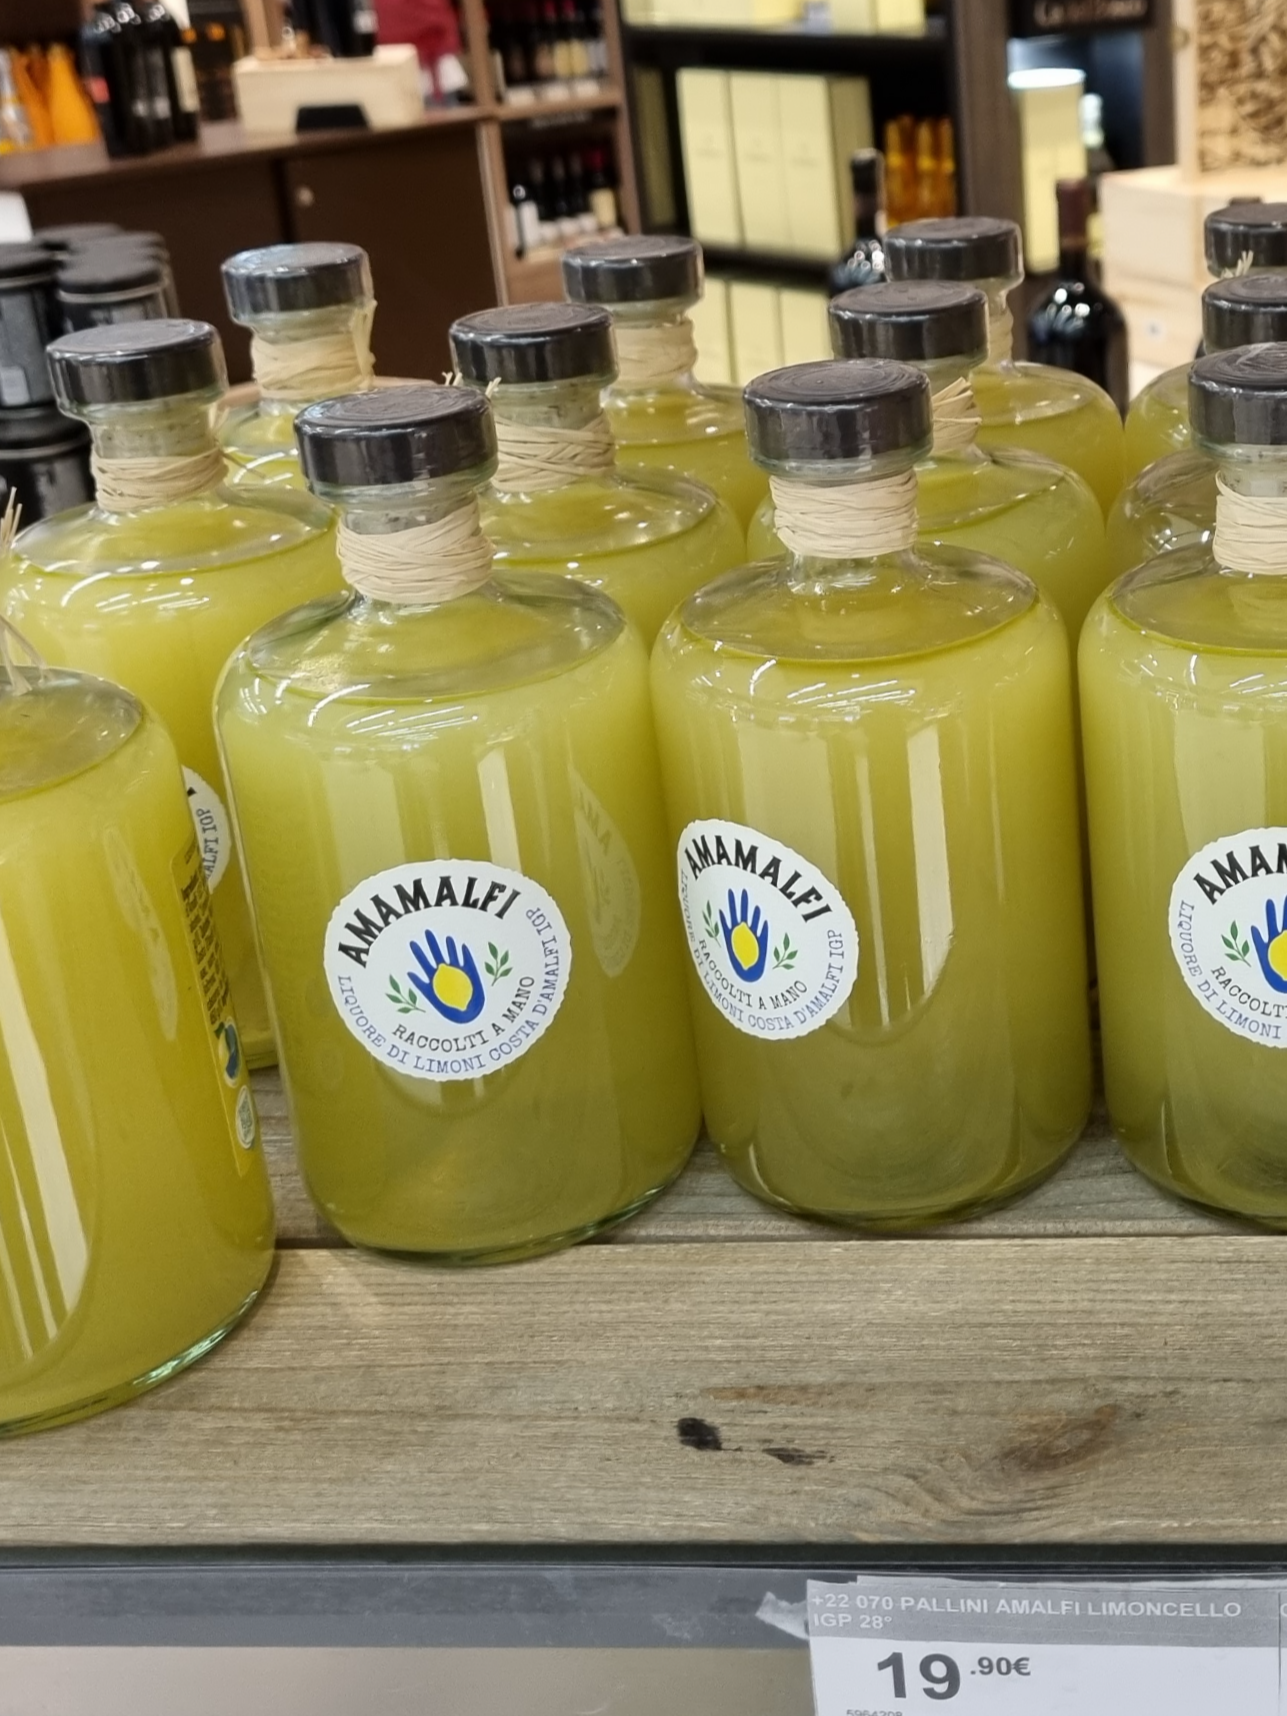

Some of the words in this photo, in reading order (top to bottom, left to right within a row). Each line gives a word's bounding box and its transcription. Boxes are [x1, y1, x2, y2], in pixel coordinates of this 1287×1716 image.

[195, 807, 218, 835] IGP
[684, 834, 833, 924] AMAMALFI
[337, 875, 522, 969] AMAMALFI
[525, 906, 553, 937] IGP
[532, 934, 560, 1017] D'AMALFI
[699, 938, 753, 1008] RACCOLTI
[757, 996, 767, 1011] A
[771, 980, 808, 1010] MANO
[703, 972, 744, 1023] LIMONI
[747, 1013, 795, 1032] COSTA
[795, 964, 845, 1025] D'AMALFI
[827, 928, 845, 962] IGP
[1178, 900, 1203, 977] LIQUORE
[1197, 979, 1218, 1002] DI
[1215, 1000, 1282, 1040] LIMONI
[338, 974, 387, 1048] LIQUORE
[392, 1023, 489, 1053] RACCOLTI
[491, 1021, 506, 1037] A
[501, 976, 535, 1024] MANO
[488, 1018, 540, 1061] COSTA
[386, 1043, 408, 1064] DI
[413, 1054, 487, 1074] LIMONI
[811, 1593, 850, 1609] +22
[855, 1594, 894, 1611] 070
[899, 1596, 989, 1615] PALLINI
[995, 1599, 1080, 1617] AMALFI
[1087, 1601, 1242, 1619] LIMONCELLO
[812, 1612, 853, 1628] IGP
[858, 1614, 893, 1630] 28°
[876, 1651, 962, 1701] 19
